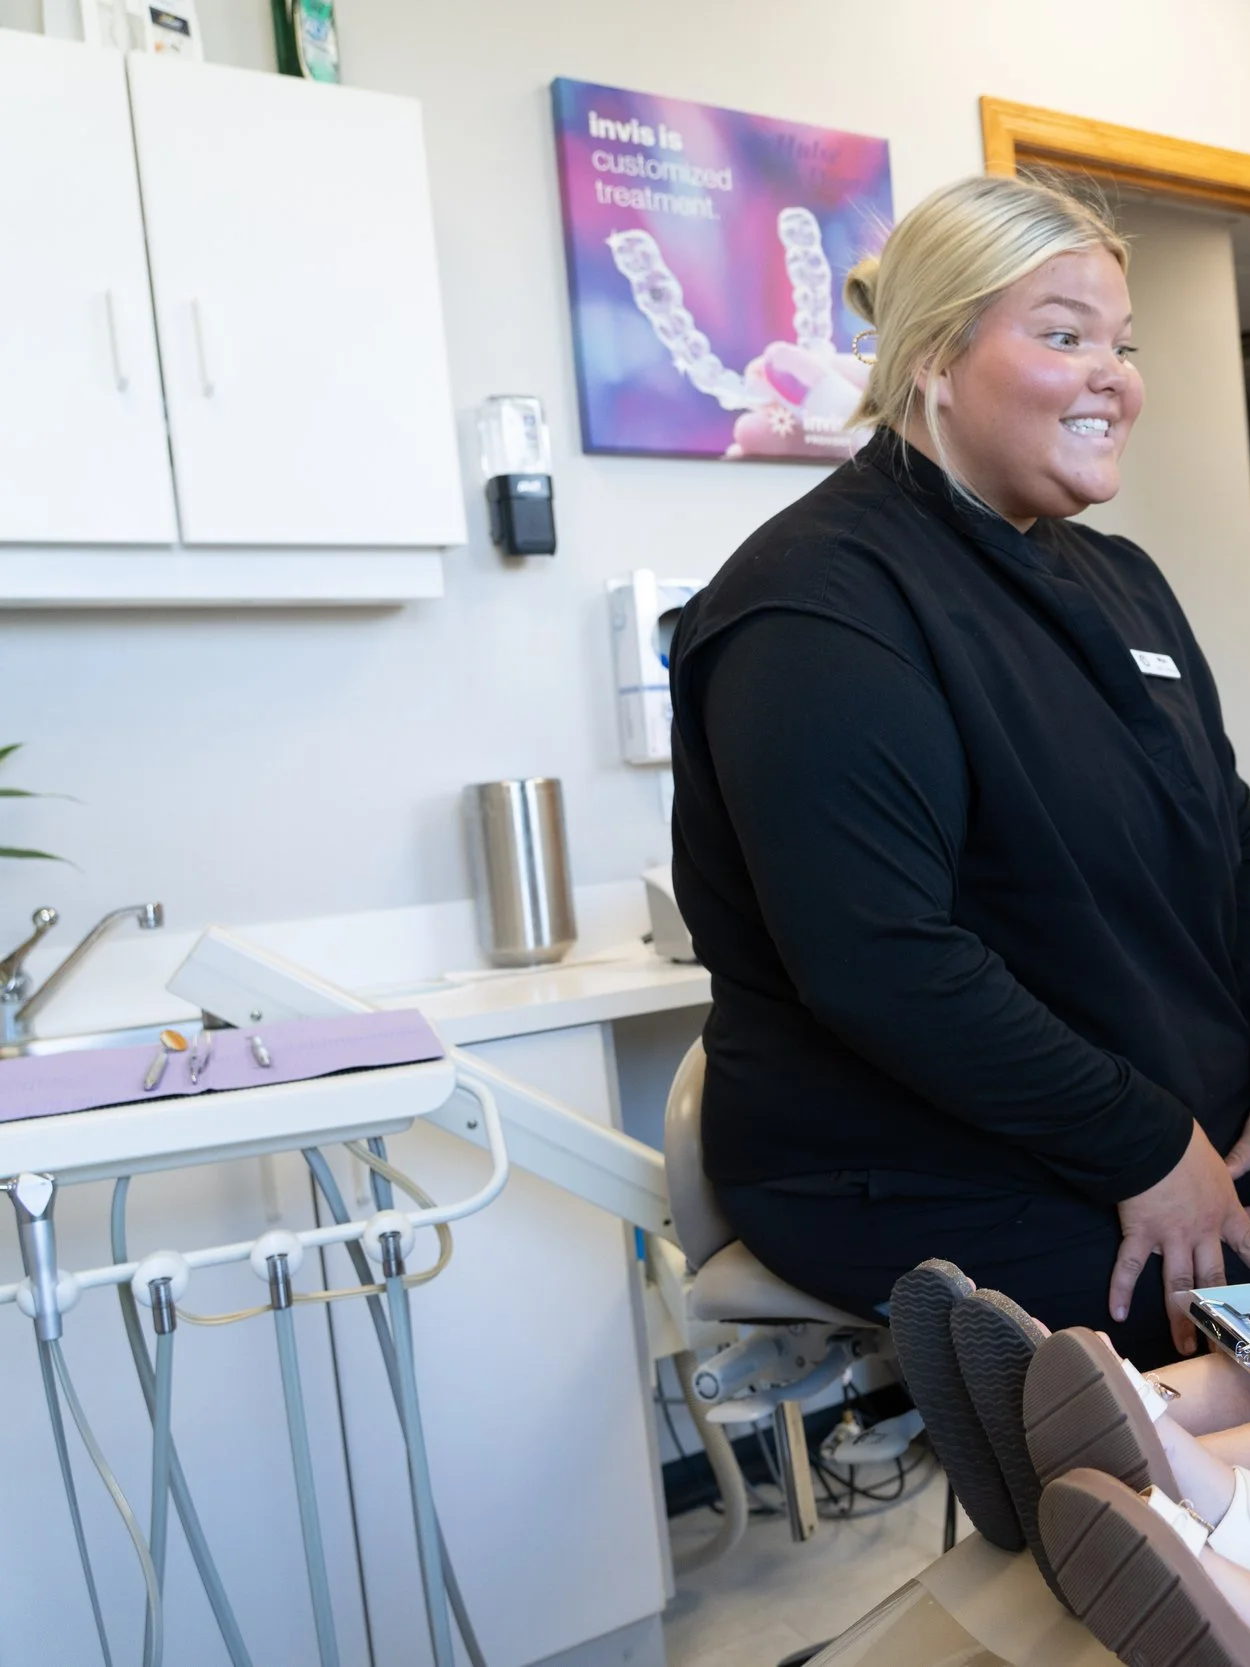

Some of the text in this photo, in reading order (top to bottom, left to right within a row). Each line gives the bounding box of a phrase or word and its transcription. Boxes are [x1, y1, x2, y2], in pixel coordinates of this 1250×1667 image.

[587, 110, 684, 152] invis is
[591, 149, 734, 192] customized
